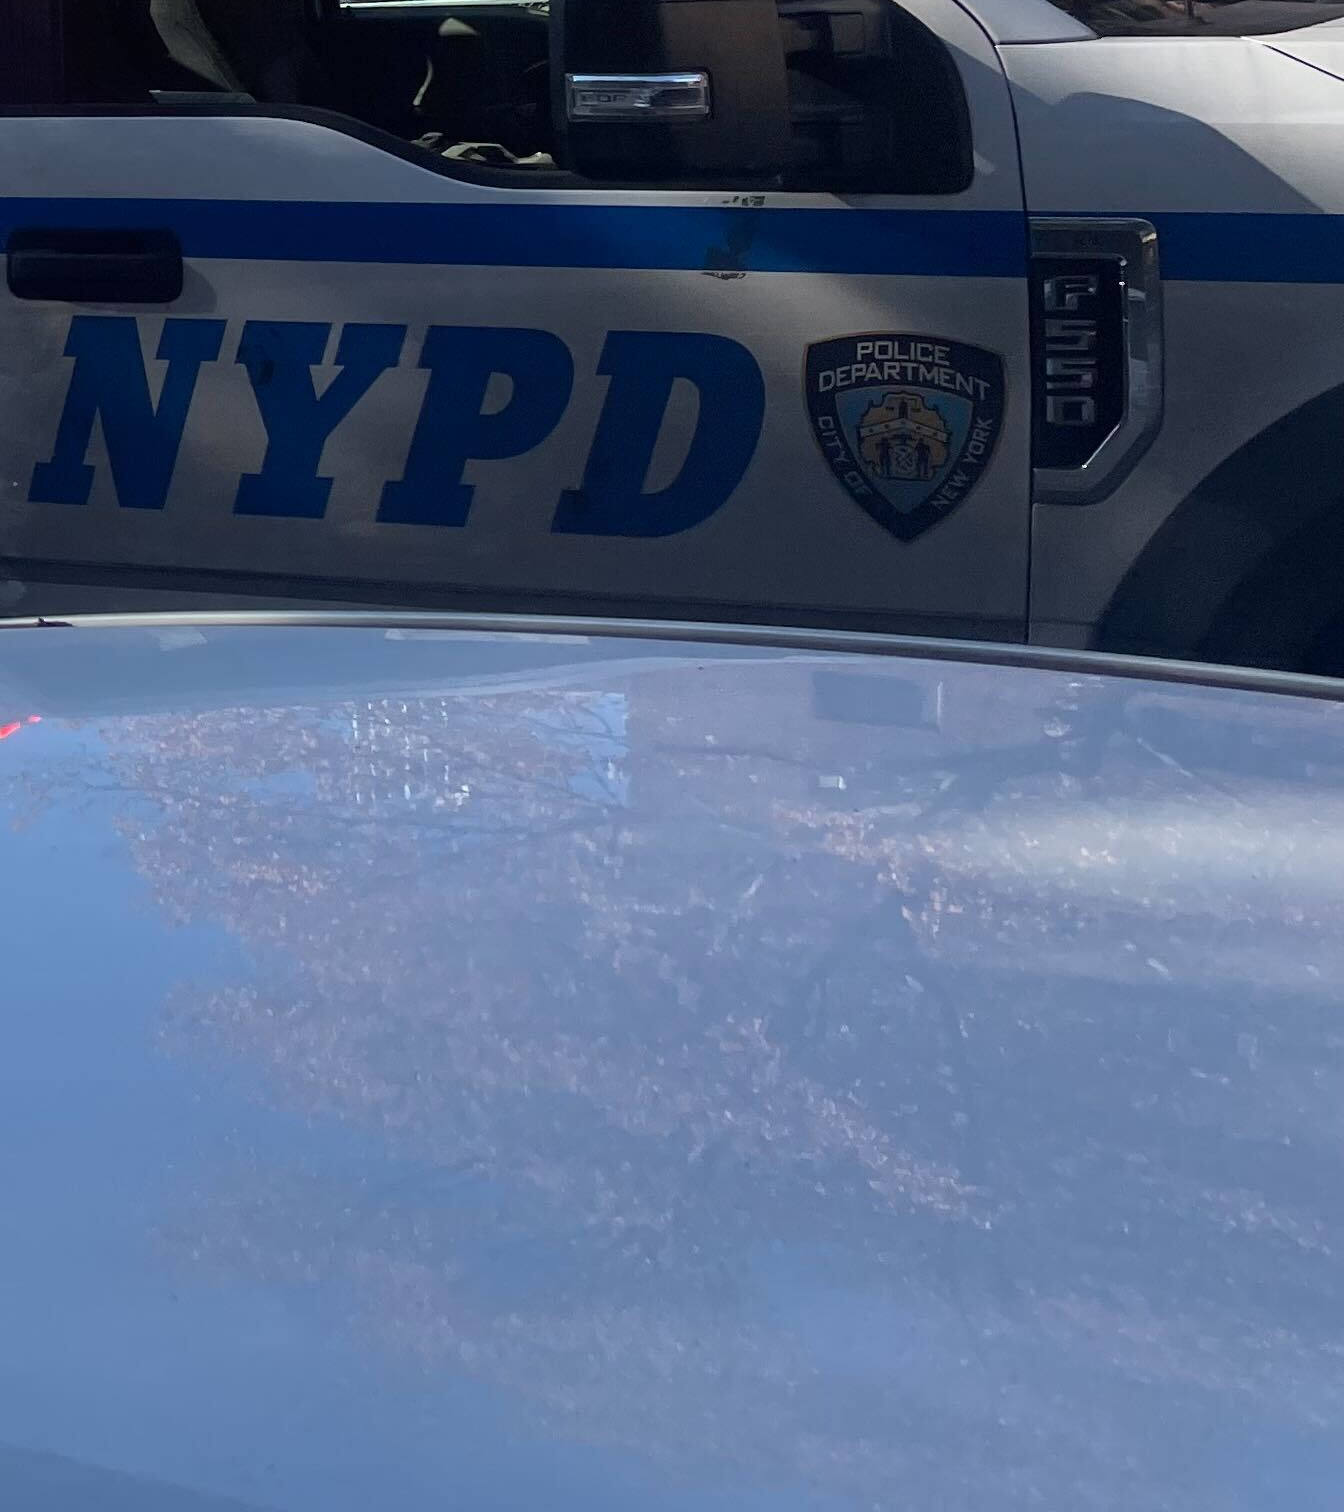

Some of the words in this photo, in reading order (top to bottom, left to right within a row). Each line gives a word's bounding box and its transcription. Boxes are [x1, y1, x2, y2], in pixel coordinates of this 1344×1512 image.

[818, 362, 991, 401] DEPARTMENT
[856, 340, 952, 366] POLICE
[1044, 274, 1098, 425] F550
[27, 314, 766, 538] NYPD
[818, 416, 850, 464] CITY
[844, 471, 873, 496] OF
[930, 470, 971, 510] NEW
[964, 418, 993, 464] YORK
